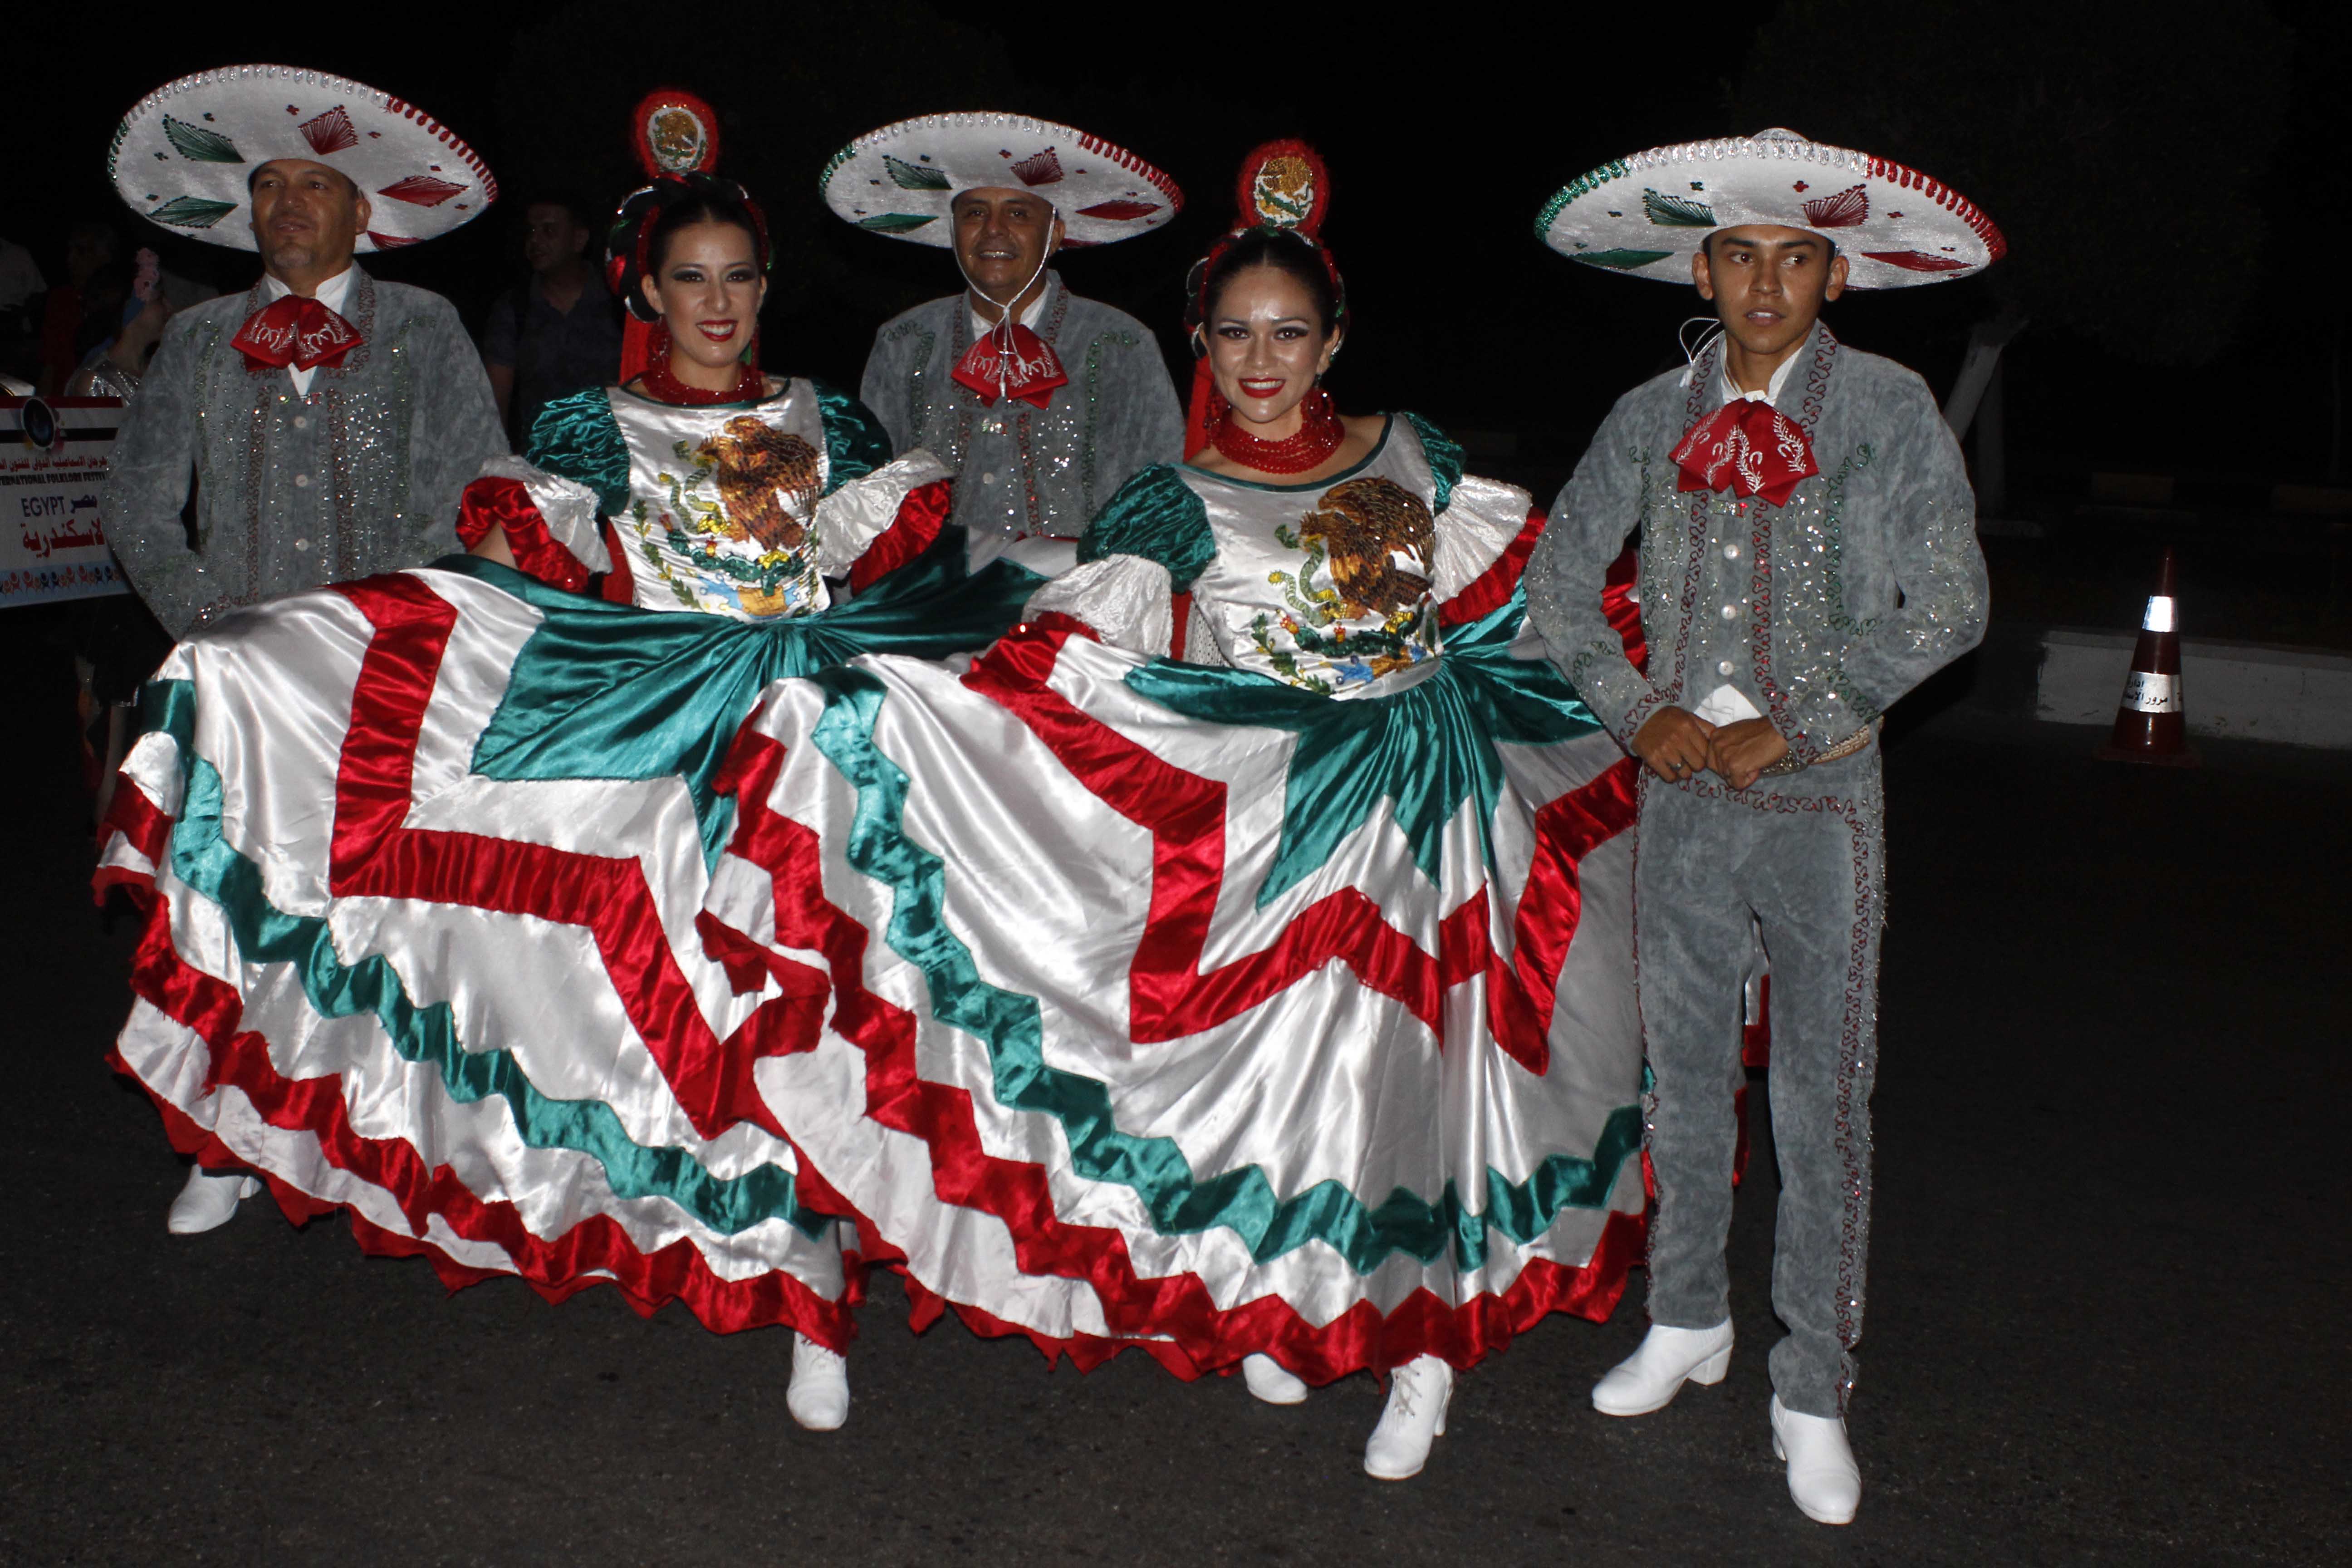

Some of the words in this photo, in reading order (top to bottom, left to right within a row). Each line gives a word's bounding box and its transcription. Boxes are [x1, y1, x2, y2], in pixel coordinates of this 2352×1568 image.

[21, 496, 65, 517] EGYPT
[70, 495, 97, 513] مصر
[2145, 697, 2168, 706] مرور
